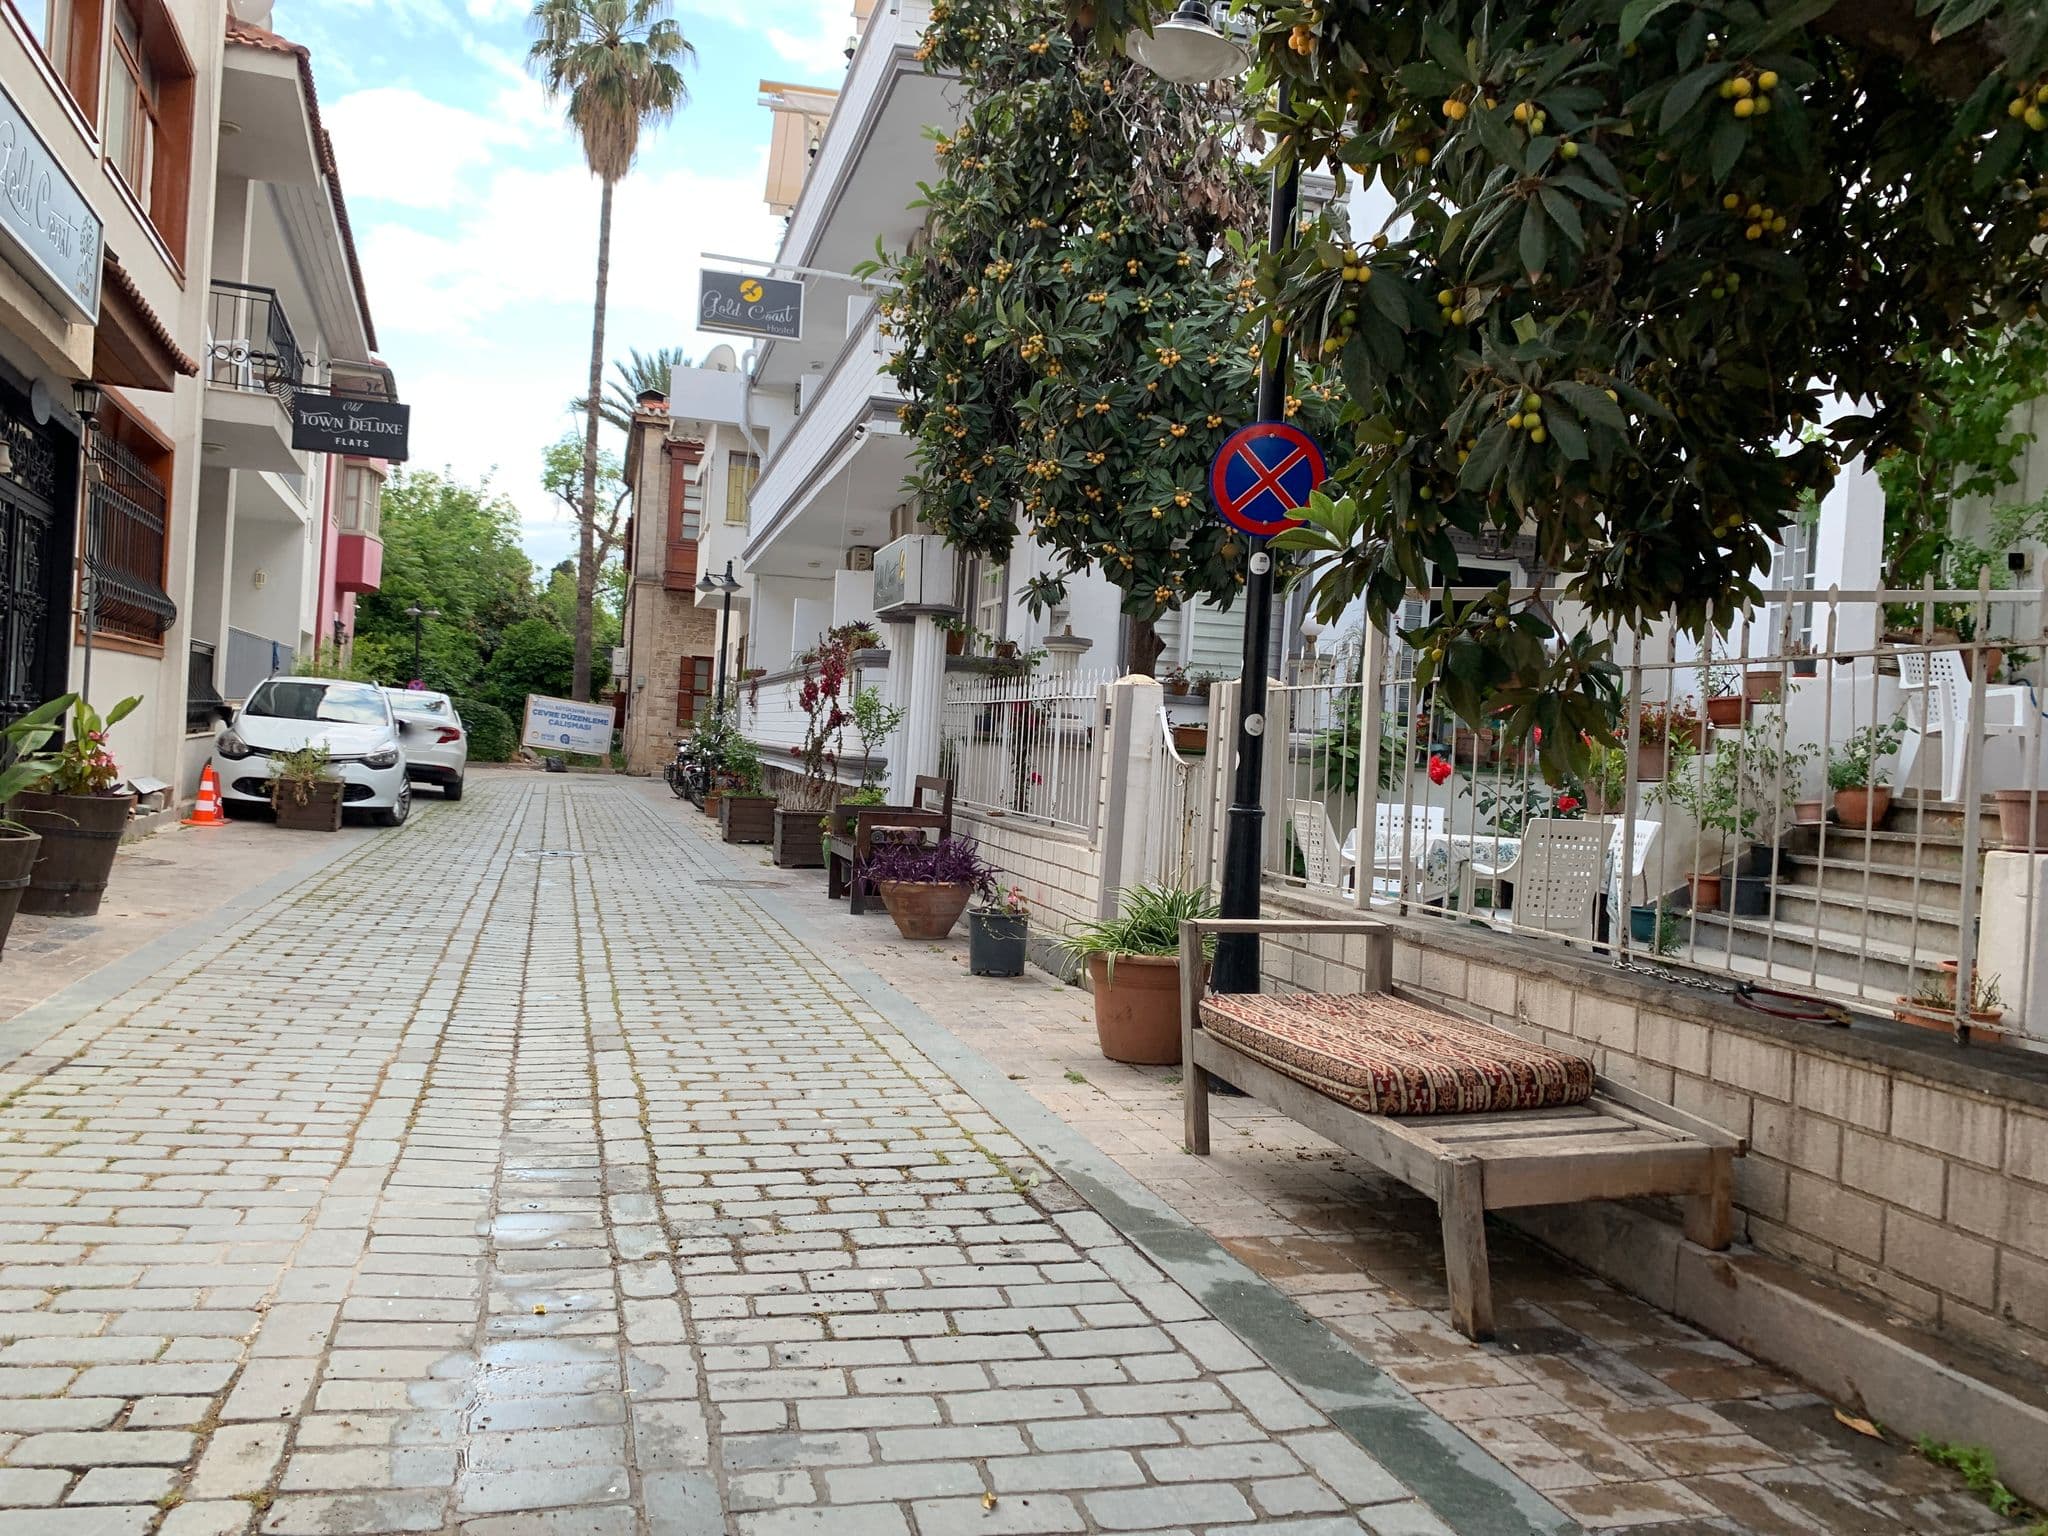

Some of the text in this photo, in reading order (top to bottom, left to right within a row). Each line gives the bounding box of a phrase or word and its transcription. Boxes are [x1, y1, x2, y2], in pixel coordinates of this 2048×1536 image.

[36, 170, 78, 260] Coast
[702, 290, 800, 322] Gold Coast
[766, 324, 795, 335] Hostel
[342, 401, 363, 412] Old
[300, 412, 403, 435] TOWN DELUXE
[335, 437, 370, 448] FLATS
